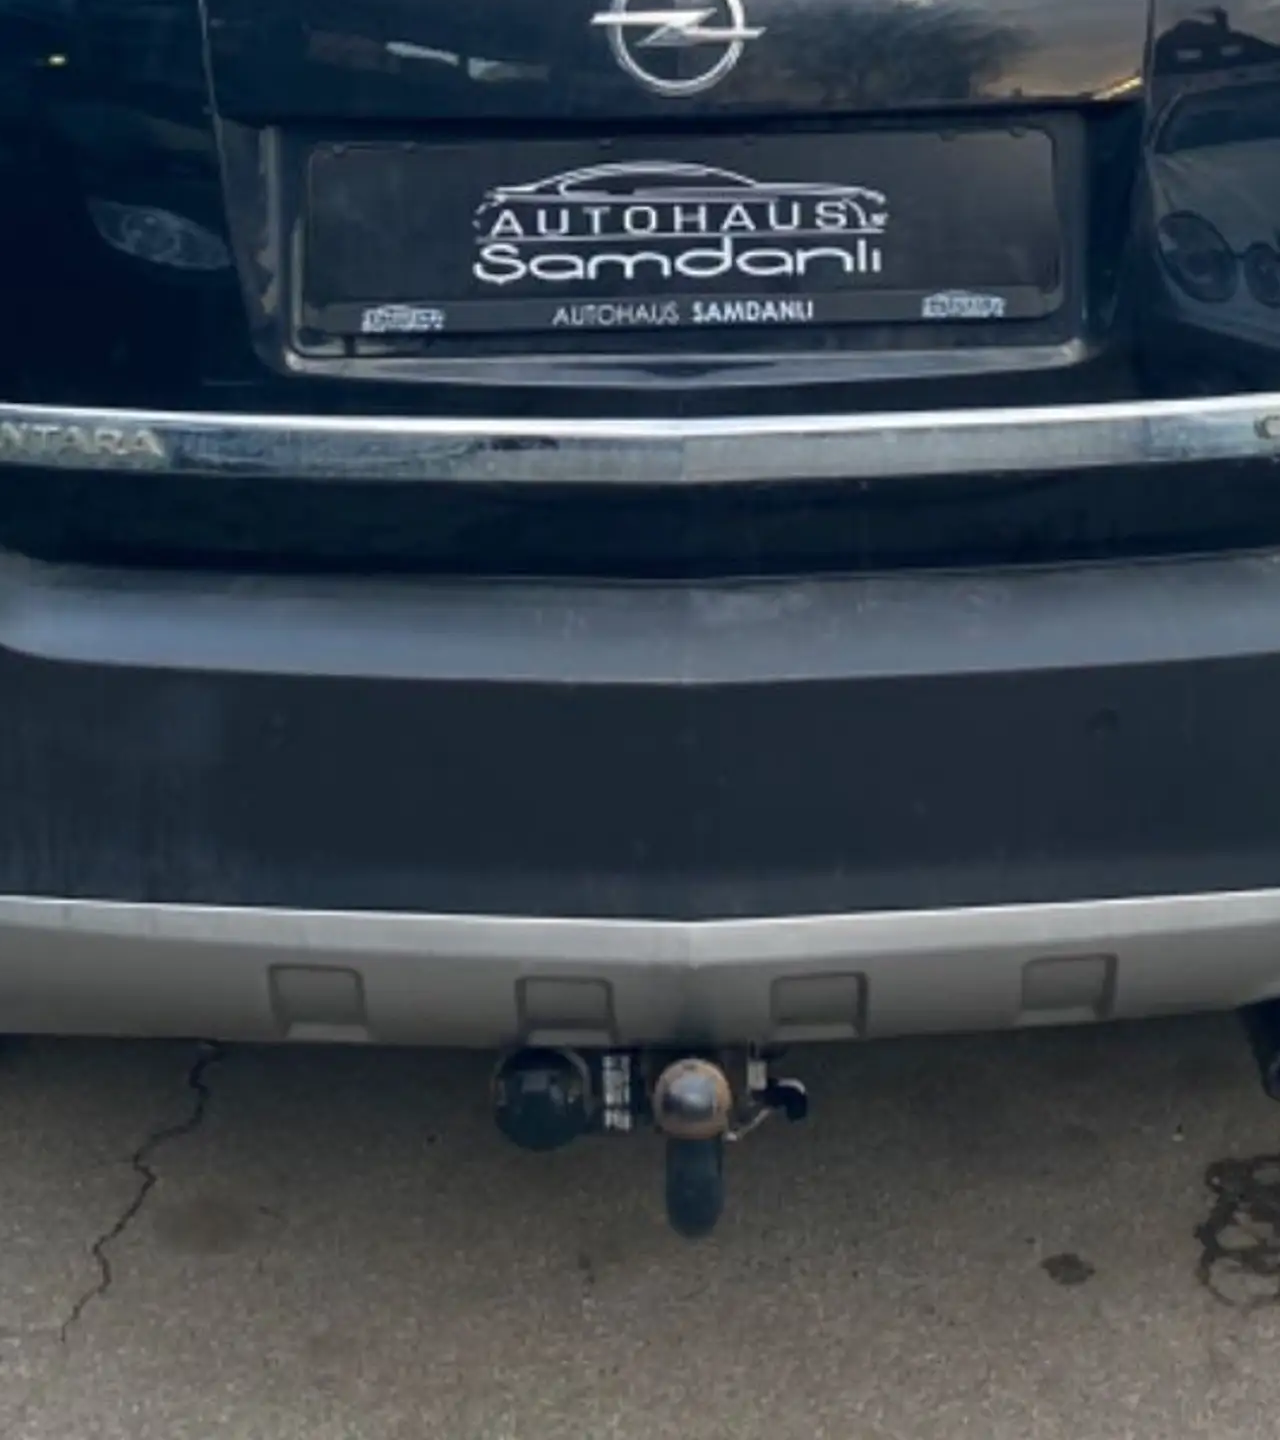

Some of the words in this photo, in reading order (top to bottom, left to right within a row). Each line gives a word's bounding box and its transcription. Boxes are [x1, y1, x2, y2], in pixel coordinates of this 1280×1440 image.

[490, 200, 850, 236] AUTOHAUS
[552, 303, 680, 326] AUTOHAUS
[693, 300, 814, 323] SAMDANLI
